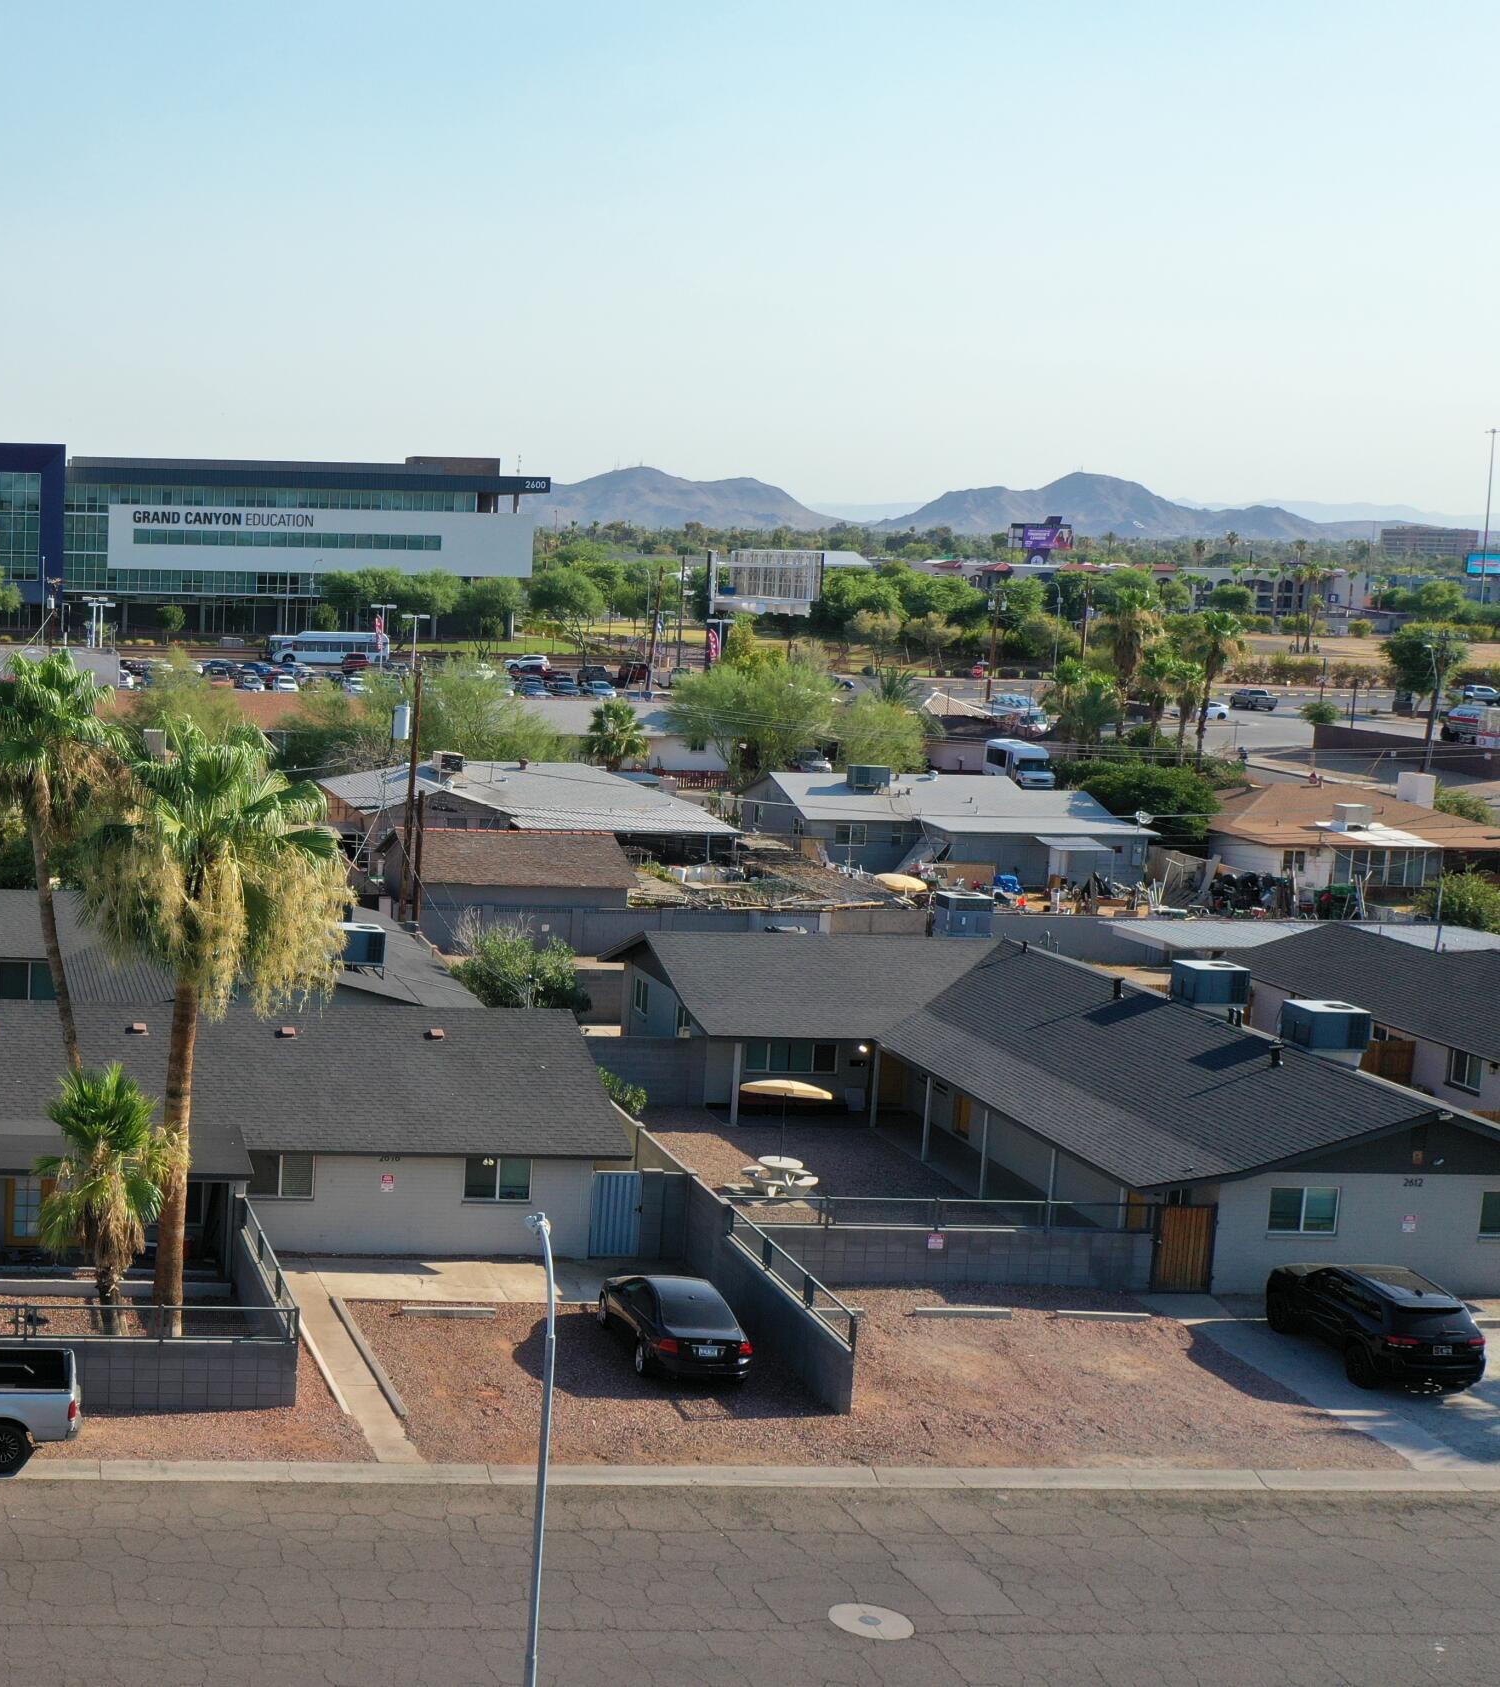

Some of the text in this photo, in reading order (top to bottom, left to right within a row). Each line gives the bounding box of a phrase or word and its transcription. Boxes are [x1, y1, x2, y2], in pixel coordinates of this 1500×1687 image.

[525, 480, 546, 489] 2600
[132, 510, 315, 528] GRAND CANYON EDUCATION
[1403, 1177, 1424, 1188] 2612
